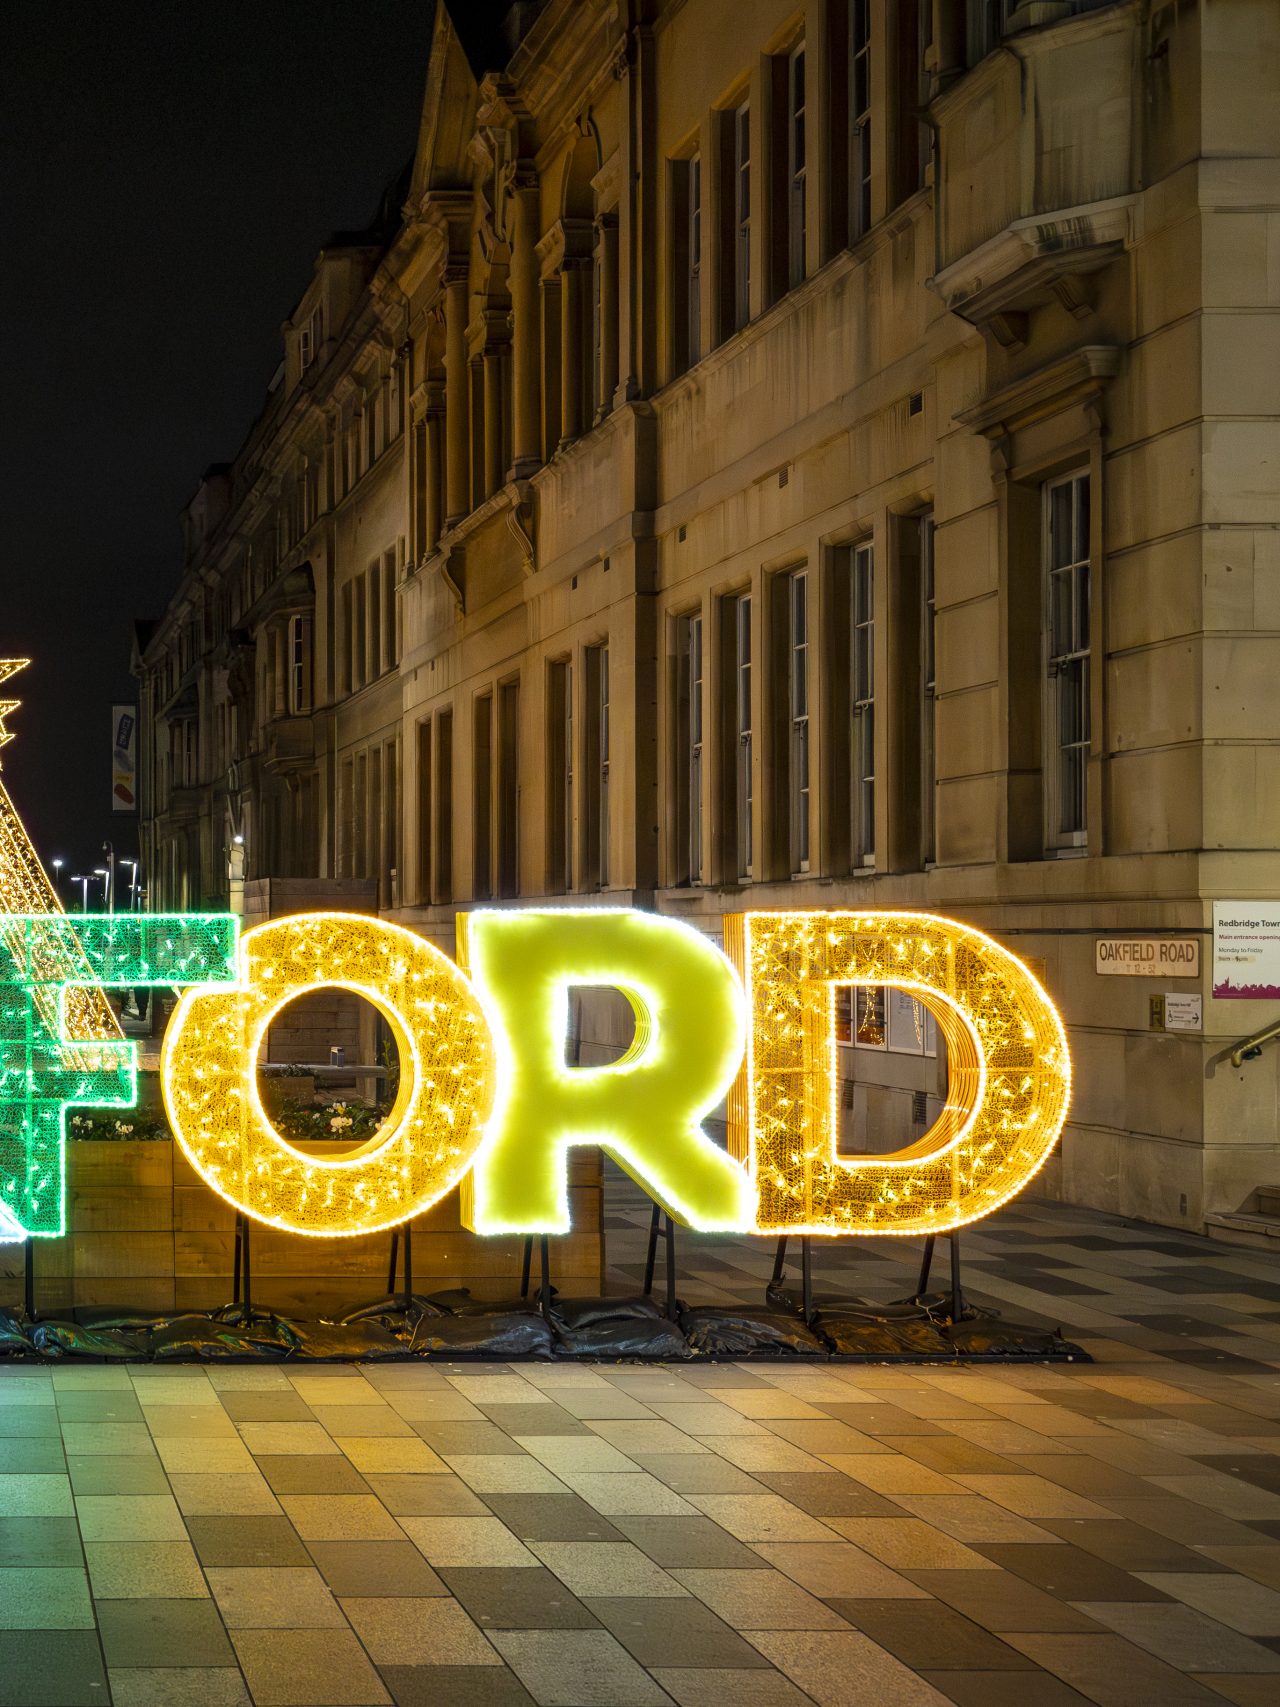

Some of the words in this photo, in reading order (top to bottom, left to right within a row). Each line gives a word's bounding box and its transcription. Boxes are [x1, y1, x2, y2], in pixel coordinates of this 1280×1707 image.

[1218, 920, 1260, 928] Redbridge
[1099, 943, 1154, 961] OAKFIELD
[1160, 943, 1195, 962] ROAD
